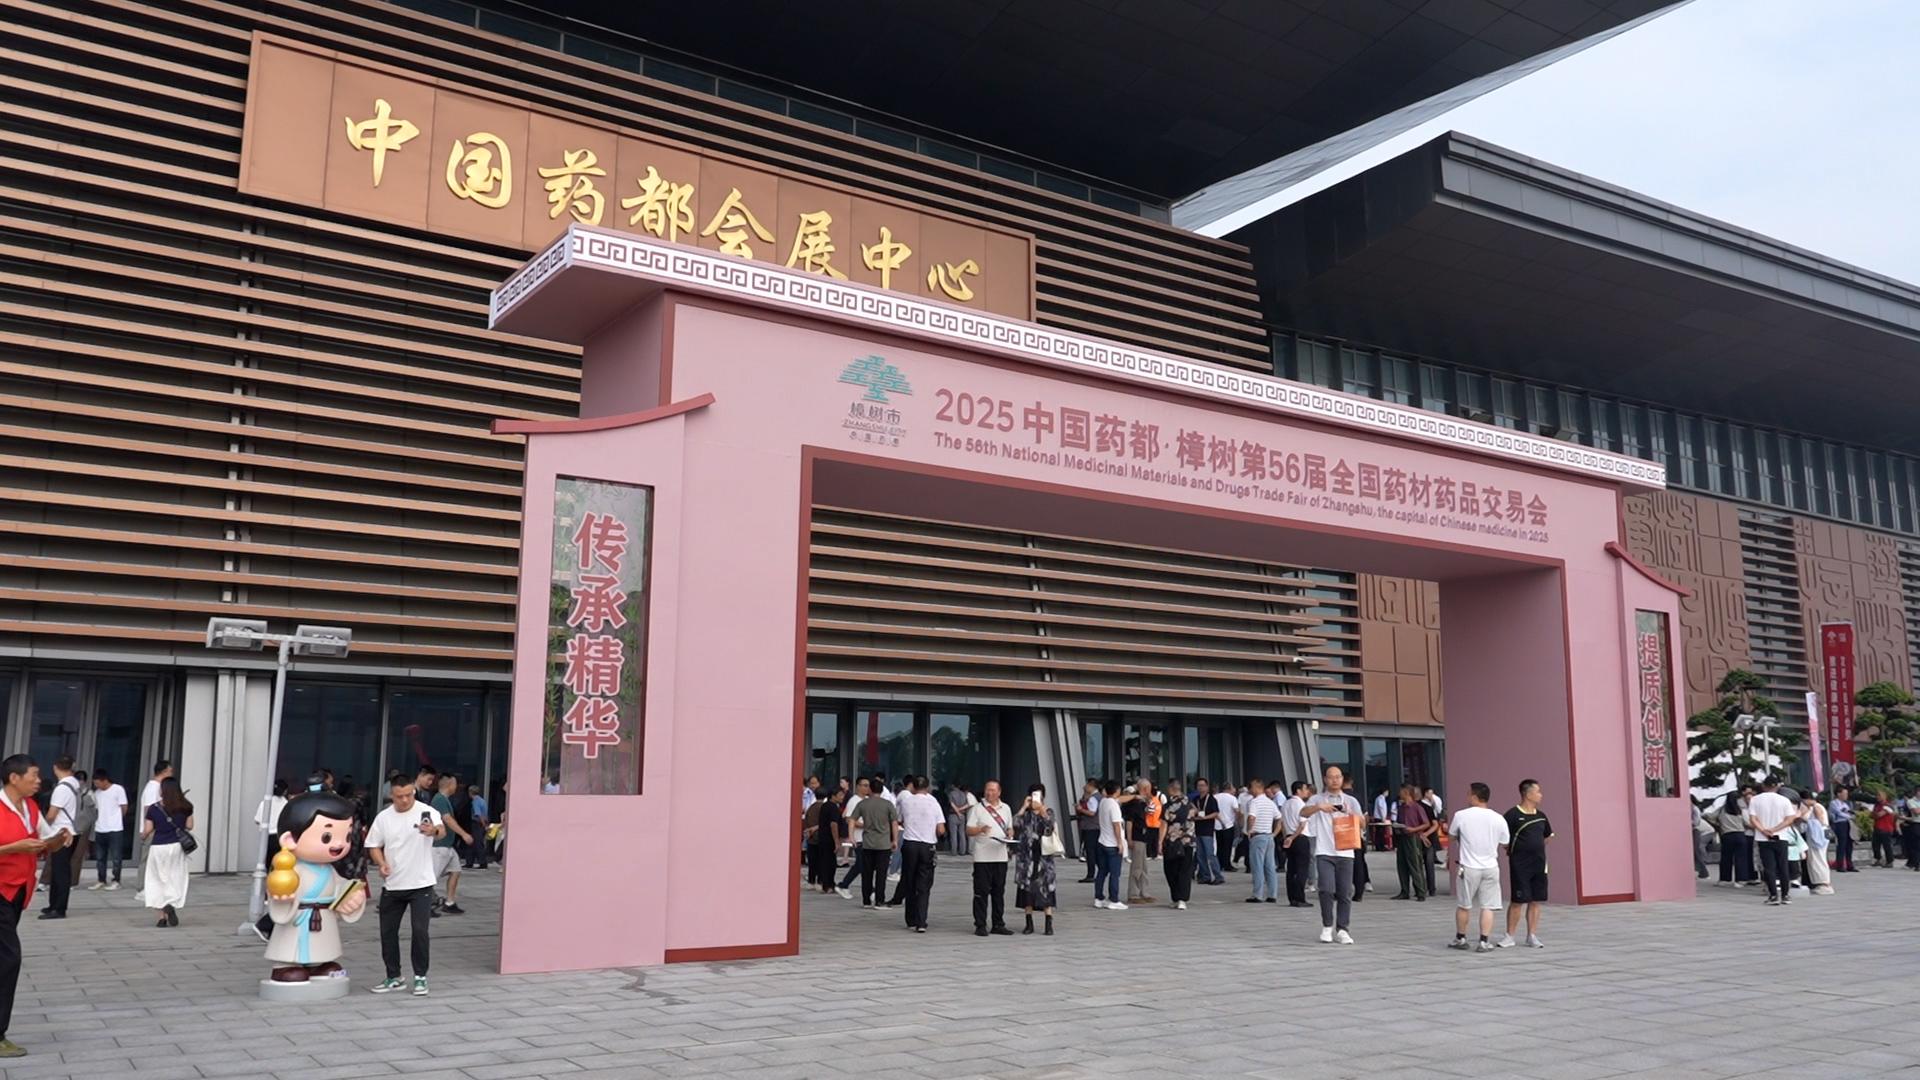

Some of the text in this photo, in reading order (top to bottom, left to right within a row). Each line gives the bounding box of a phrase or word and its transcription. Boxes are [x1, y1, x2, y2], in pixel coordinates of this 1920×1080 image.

[344, 98, 980, 301] 中国药都会展中心
[934, 431, 961, 450] The
[965, 436, 998, 457] 56th
[1002, 443, 1061, 467] National
[1064, 453, 1128, 477] Medicinal
[1131, 464, 1188, 487] Materials
[1190, 477, 1213, 491] and
[1216, 479, 1250, 499] Drugs
[1252, 485, 1285, 502] Trade
[1287, 491, 1308, 506] Fair
[1310, 495, 1321, 508] of
[1322, 496, 1377, 518] Zhangshu,
[1378, 506, 1394, 520] the
[1395, 509, 1427, 525] capital
[1429, 514, 1440, 526] of
[1440, 515, 1478, 533] Chinese
[1478, 522, 1517, 539] medicine
[563, 511, 630, 758] 传承精华
[1639, 632, 1665, 780] 提质创新
